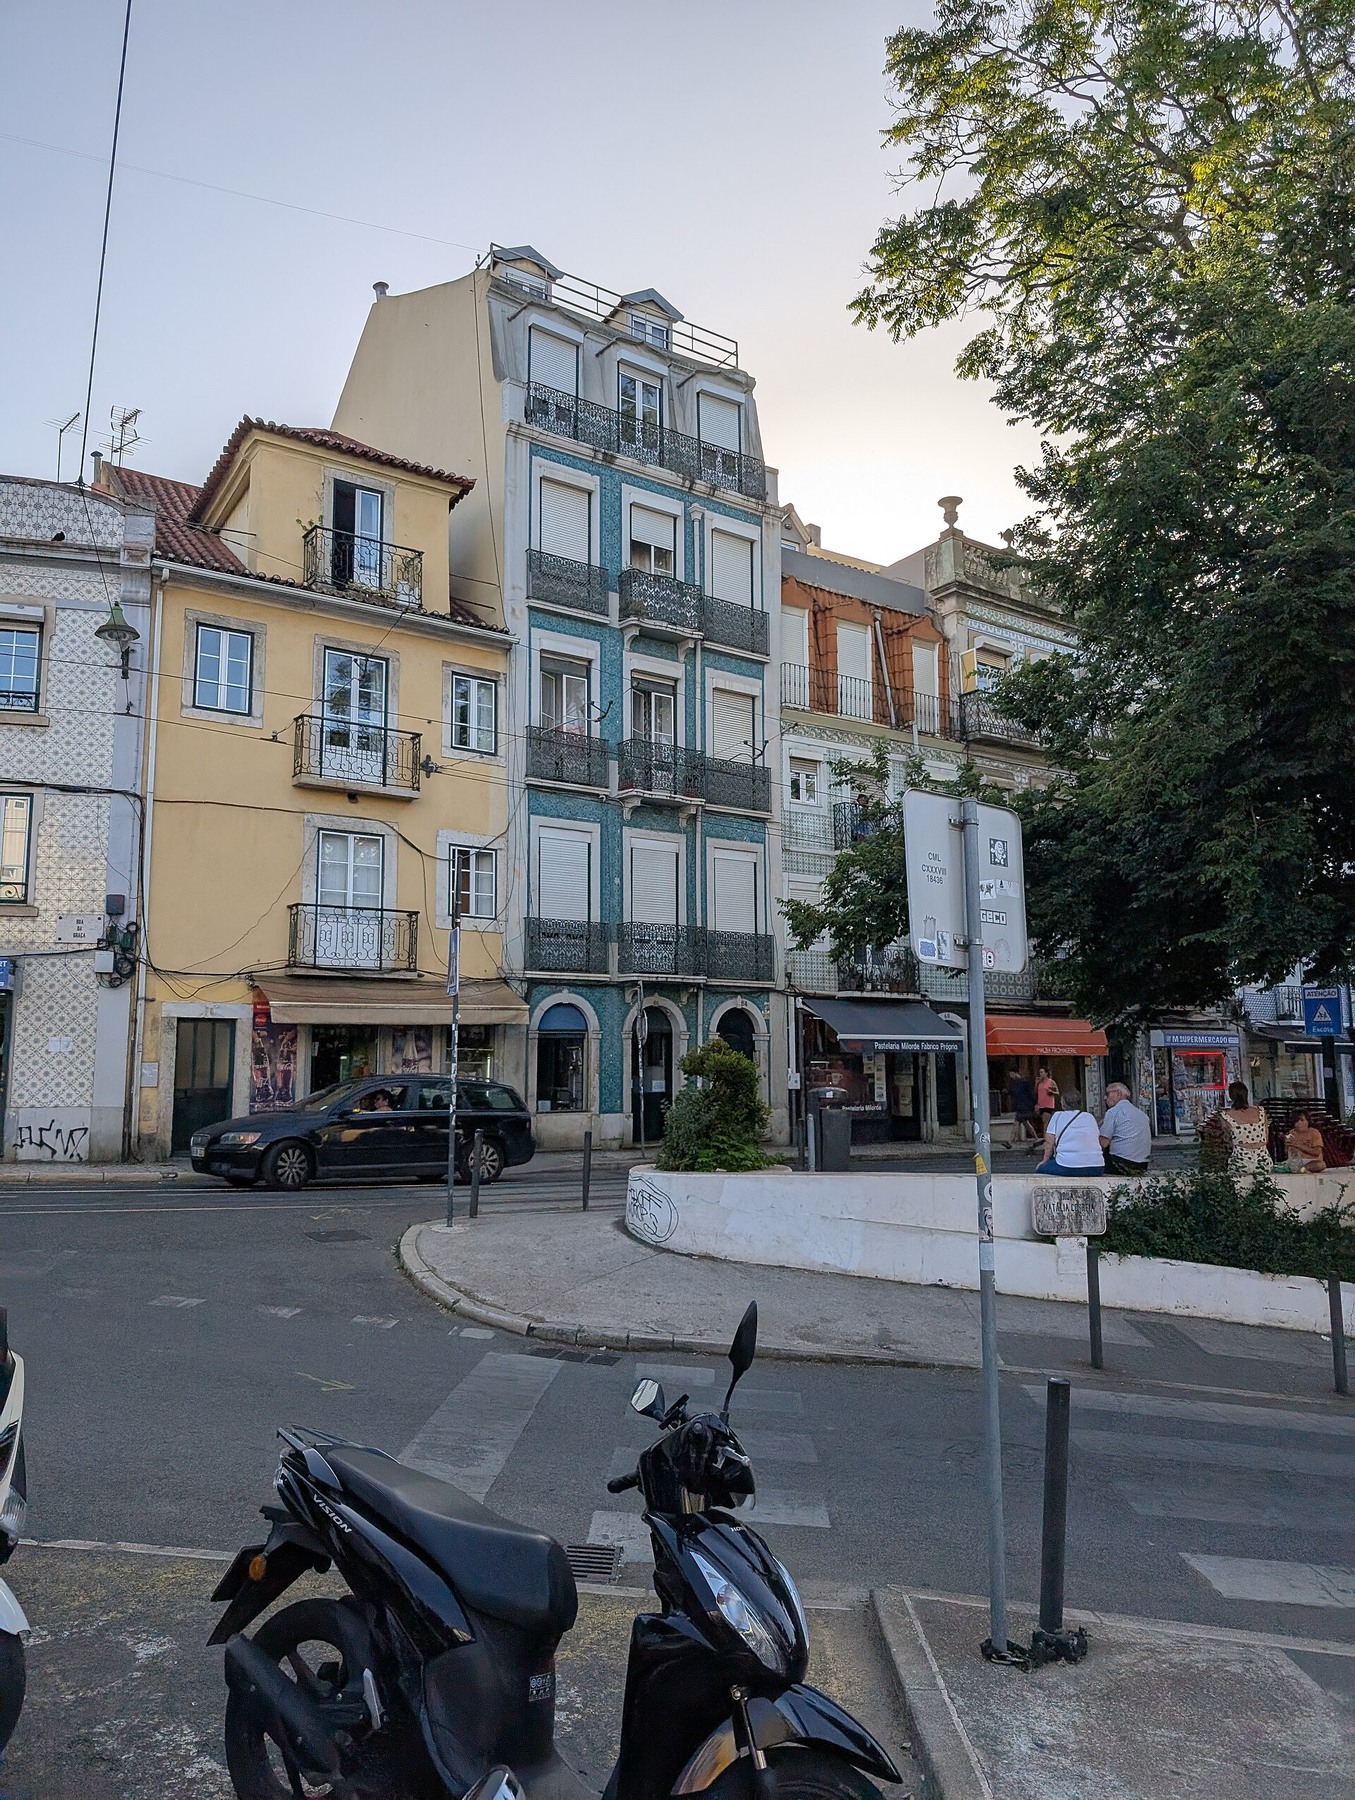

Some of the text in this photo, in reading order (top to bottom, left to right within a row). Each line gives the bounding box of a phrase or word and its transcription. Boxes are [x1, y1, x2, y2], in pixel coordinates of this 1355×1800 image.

[1307, 990, 1337, 998] ATENÇÃO
[874, 1041, 900, 1050] Pastelaria
[901, 1042, 920, 1050] Milorde
[313, 1493, 352, 1533] VISION
